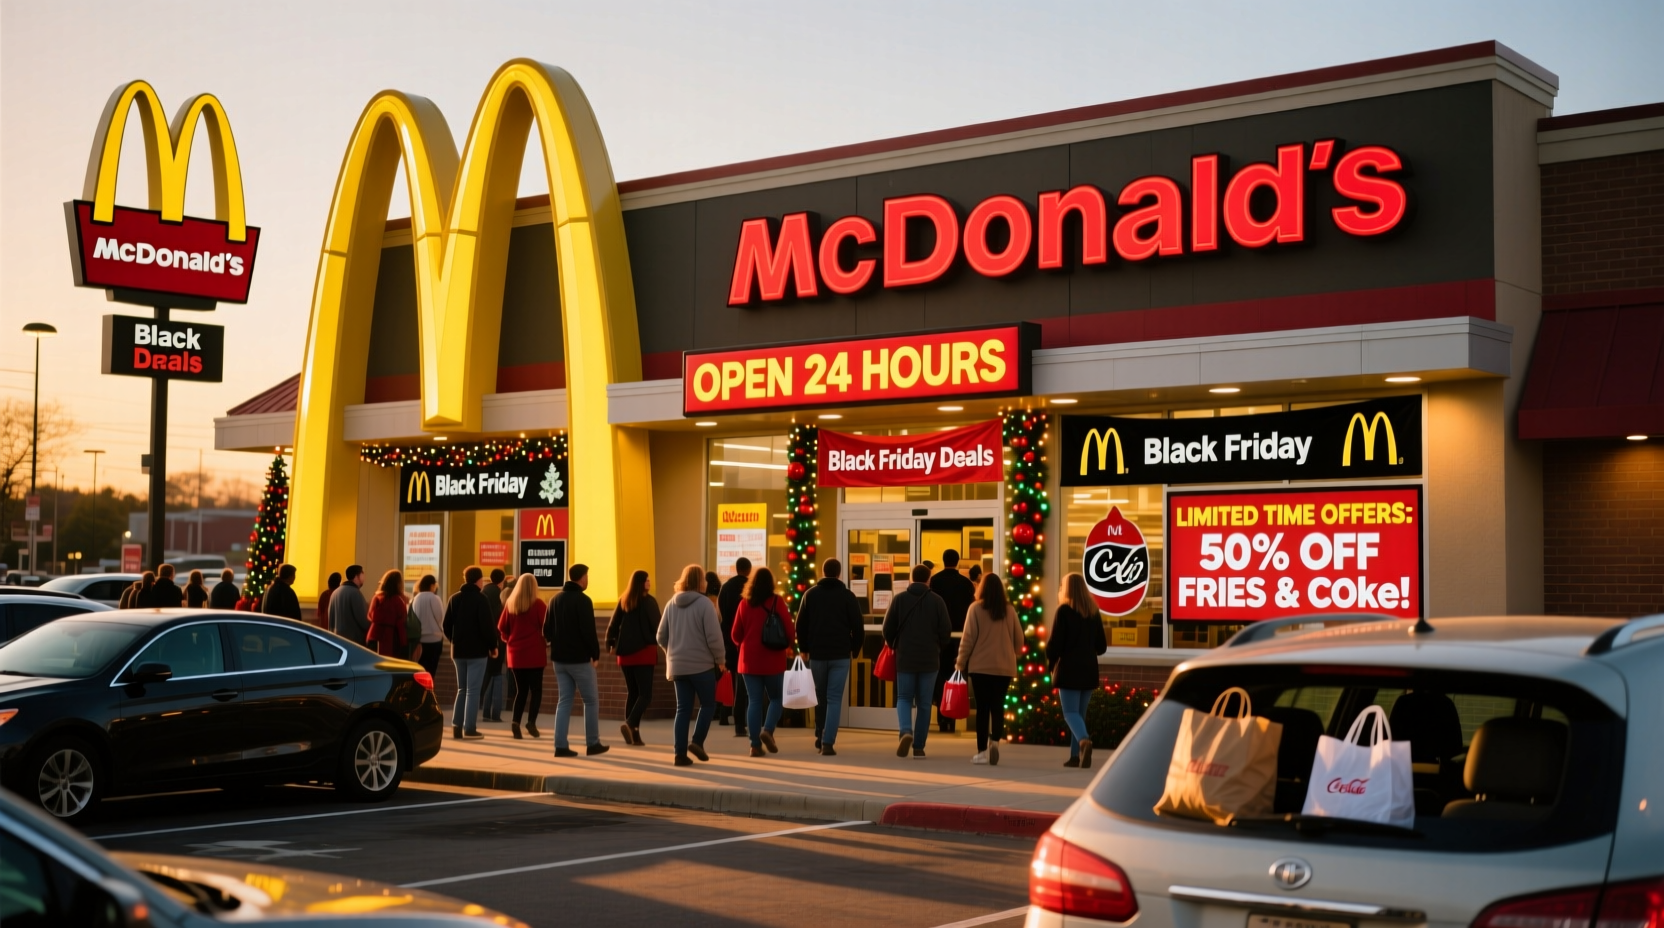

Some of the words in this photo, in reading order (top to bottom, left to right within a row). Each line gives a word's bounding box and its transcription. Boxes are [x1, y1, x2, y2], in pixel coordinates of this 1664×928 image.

[727, 139, 1407, 308] McDonald's
[92, 236, 245, 277] McDonald's
[134, 323, 202, 350] Black
[691, 355, 794, 403] OPEN
[803, 350, 853, 396] 24
[861, 338, 1006, 391] HOURS
[828, 449, 876, 472] Black
[878, 447, 937, 475] Friday
[939, 443, 994, 469] Deals
[1144, 435, 1218, 465] Black
[1224, 431, 1313, 466] Friday
[435, 473, 476, 497] Black
[478, 471, 529, 499] Friday
[1176, 505, 1259, 527] LIMITED
[1263, 503, 1316, 526] TIME
[1320, 501, 1414, 525] OFFERS:
[1199, 532, 1290, 572] 50%
[1299, 532, 1380, 571] OFF
[1178, 576, 1267, 609] FRIES
[1274, 576, 1300, 609] &
